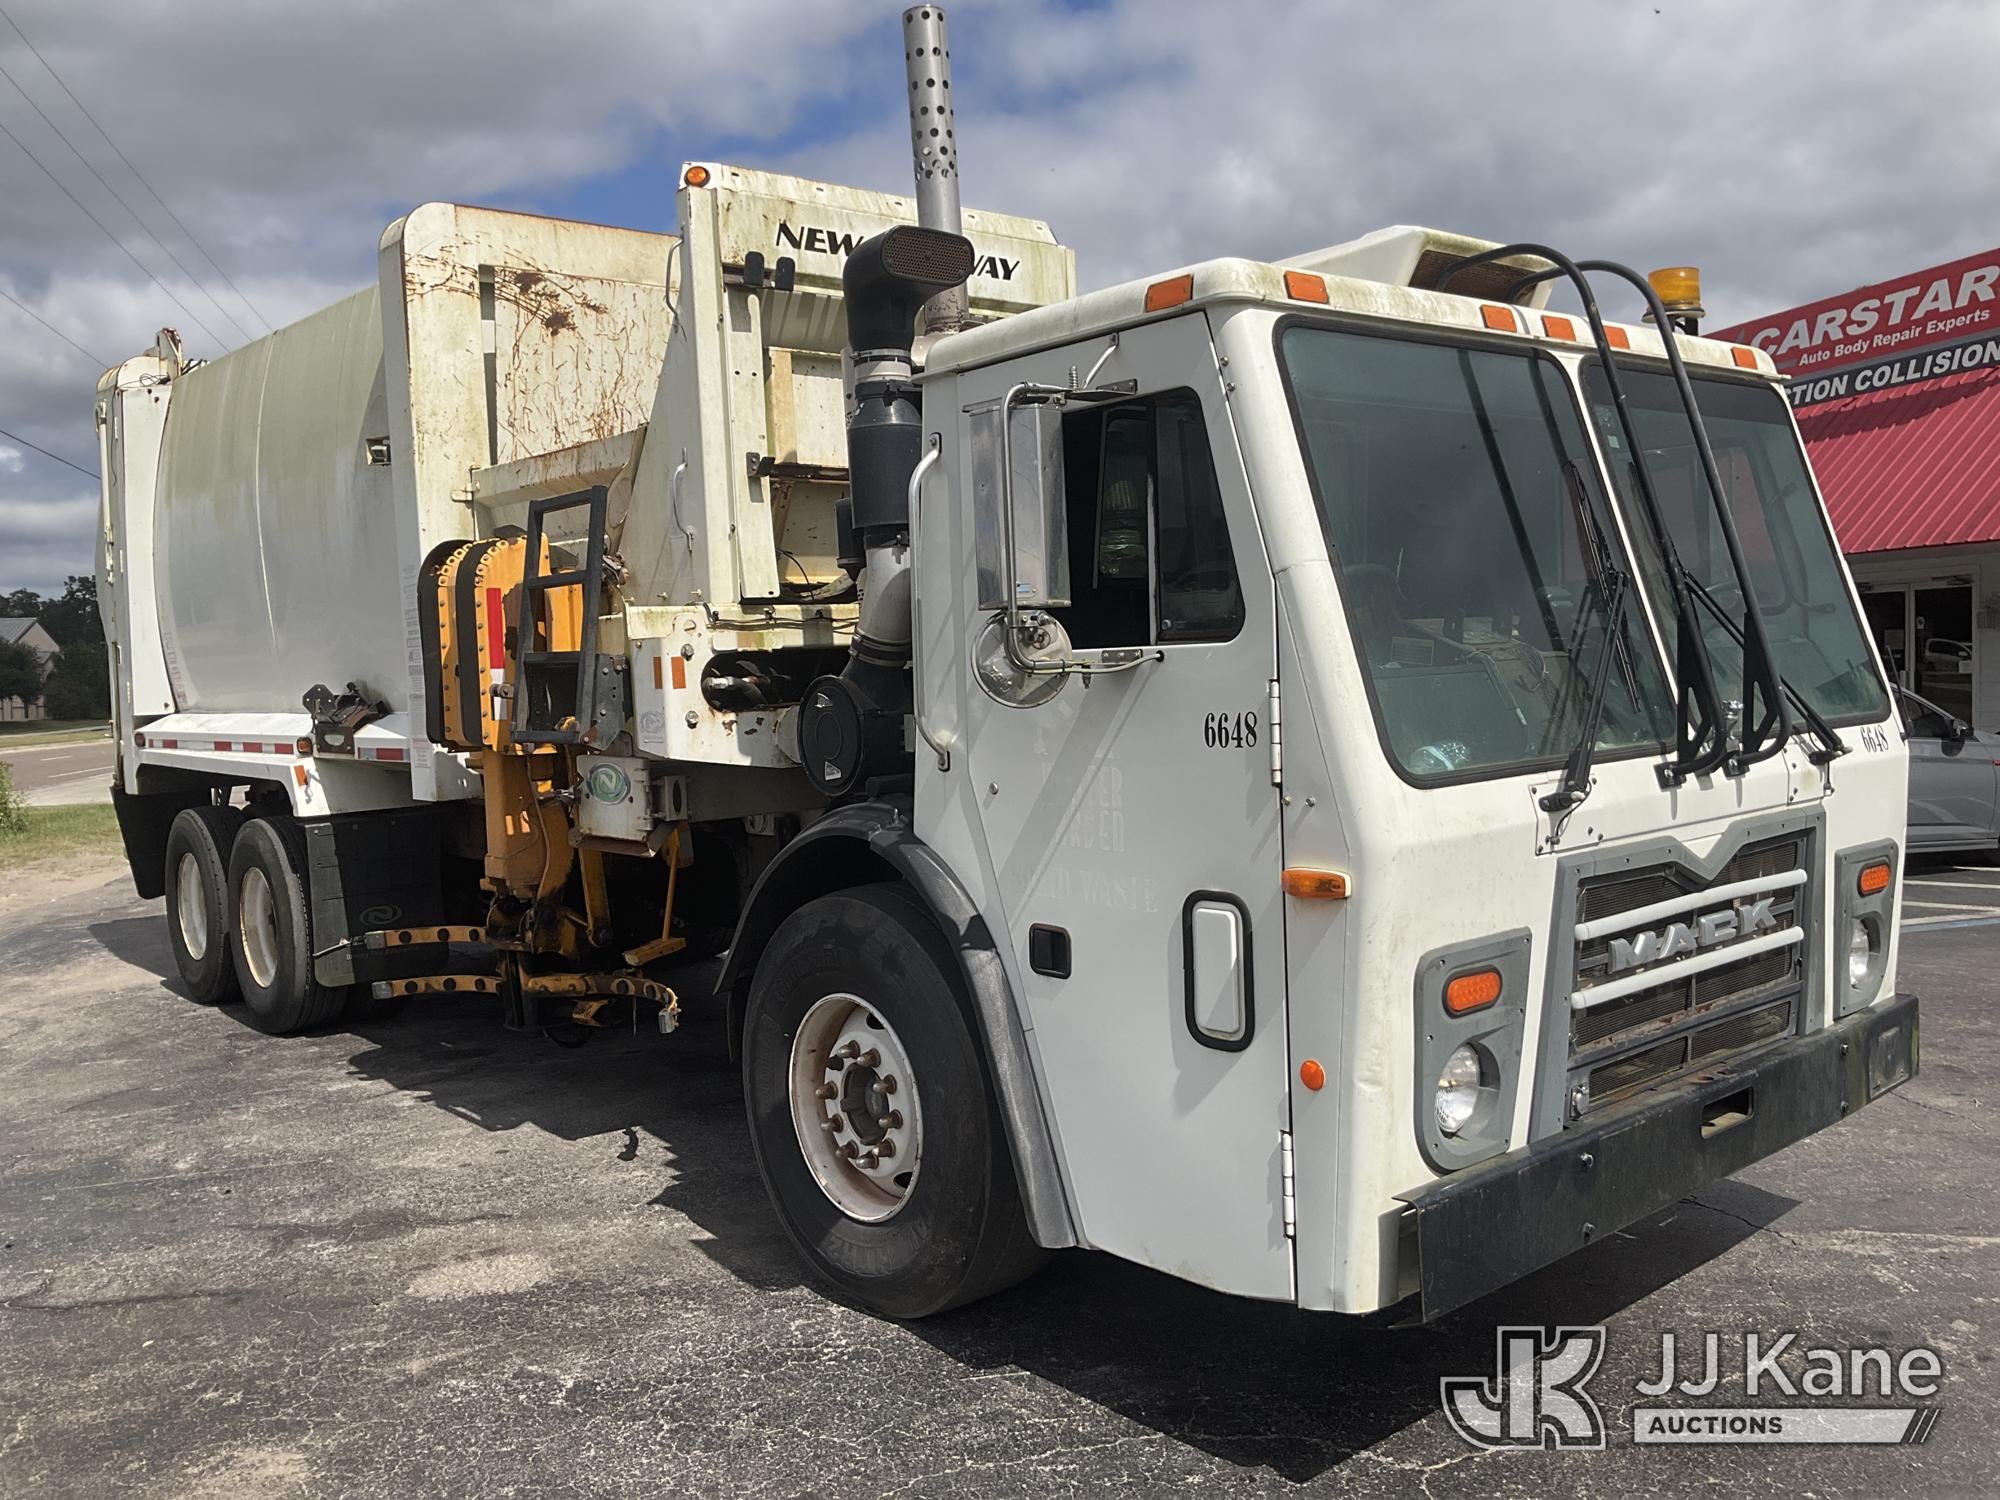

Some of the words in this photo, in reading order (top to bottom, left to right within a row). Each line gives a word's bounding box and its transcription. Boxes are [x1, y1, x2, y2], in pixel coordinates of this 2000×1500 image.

[776, 220, 864, 256] NEW
[1750, 265, 2000, 355] CARSTAR
[1799, 350, 1830, 366] Auto
[1834, 340, 1870, 358] Body
[1873, 325, 1923, 347] Repair
[1926, 309, 1990, 334] Experts
[1855, 341, 2000, 391] COLLISION
[1204, 711, 1257, 748] 6648
[1860, 725, 1889, 753] 6648
[1608, 897, 1777, 974] MACK
